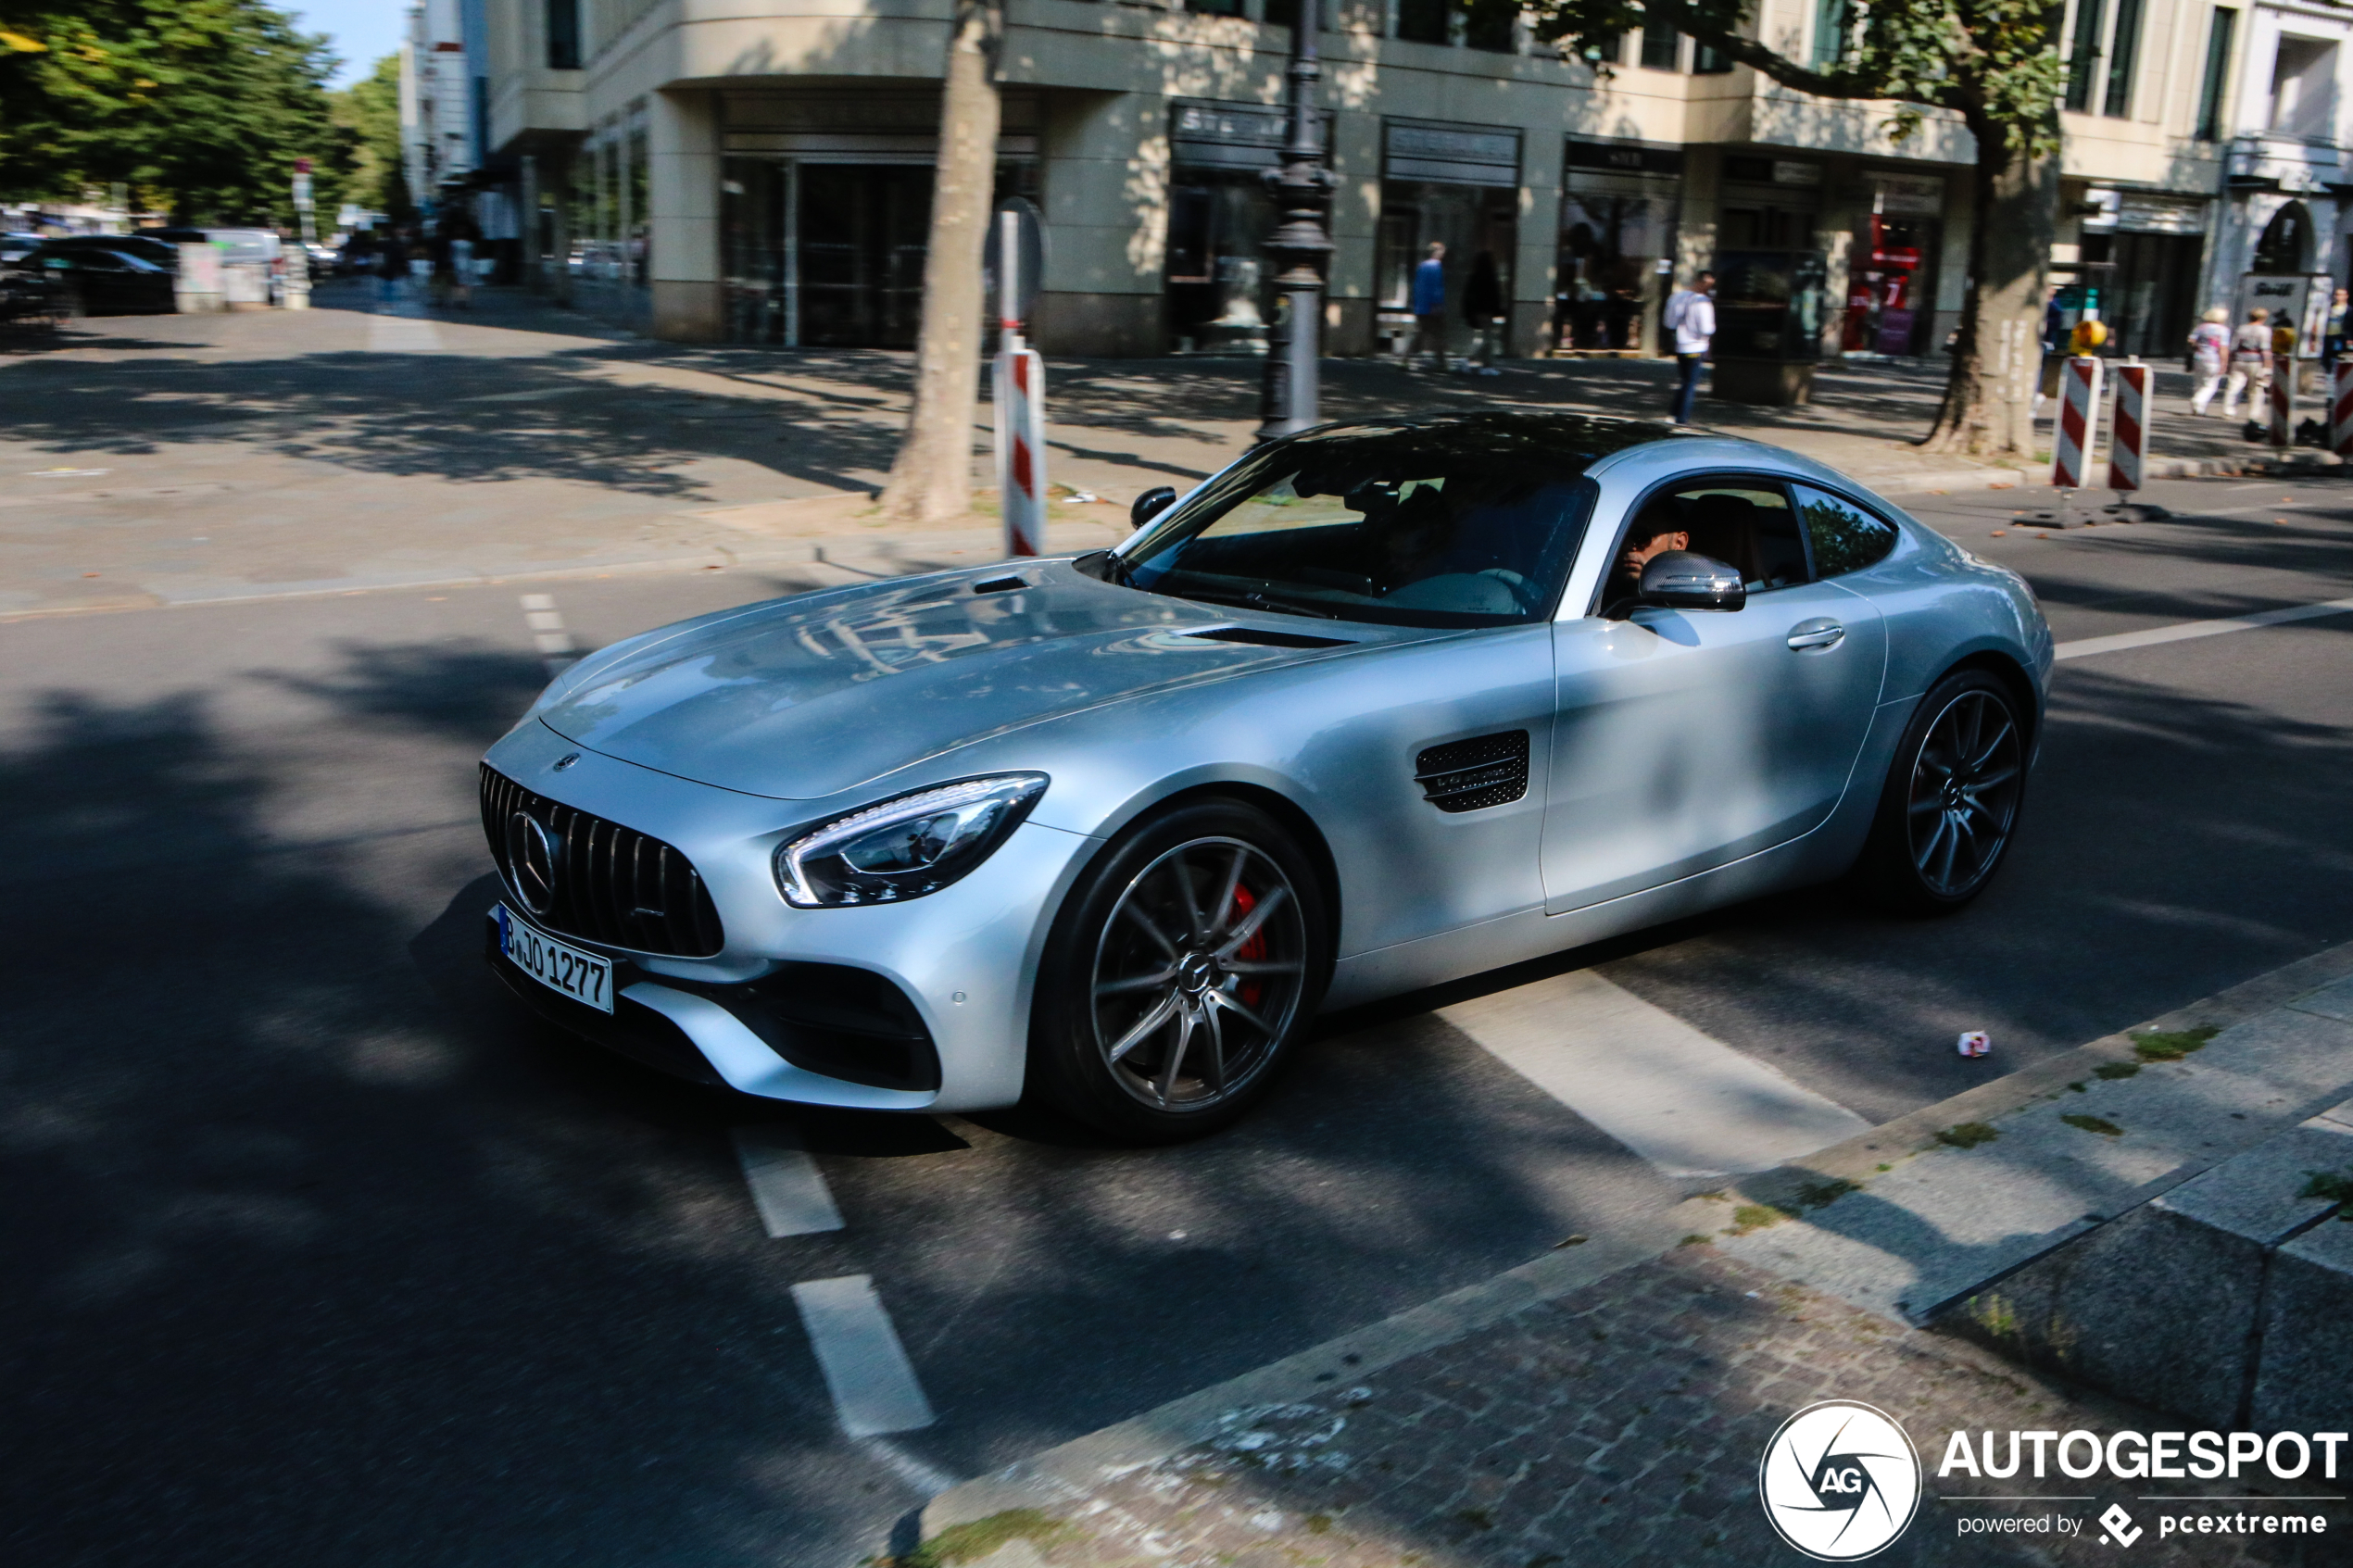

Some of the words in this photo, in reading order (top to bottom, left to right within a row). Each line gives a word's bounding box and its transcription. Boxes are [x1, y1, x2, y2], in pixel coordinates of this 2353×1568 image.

[507, 917, 515, 956] B
[523, 931, 544, 977] JO
[547, 947, 605, 1002] 1277
